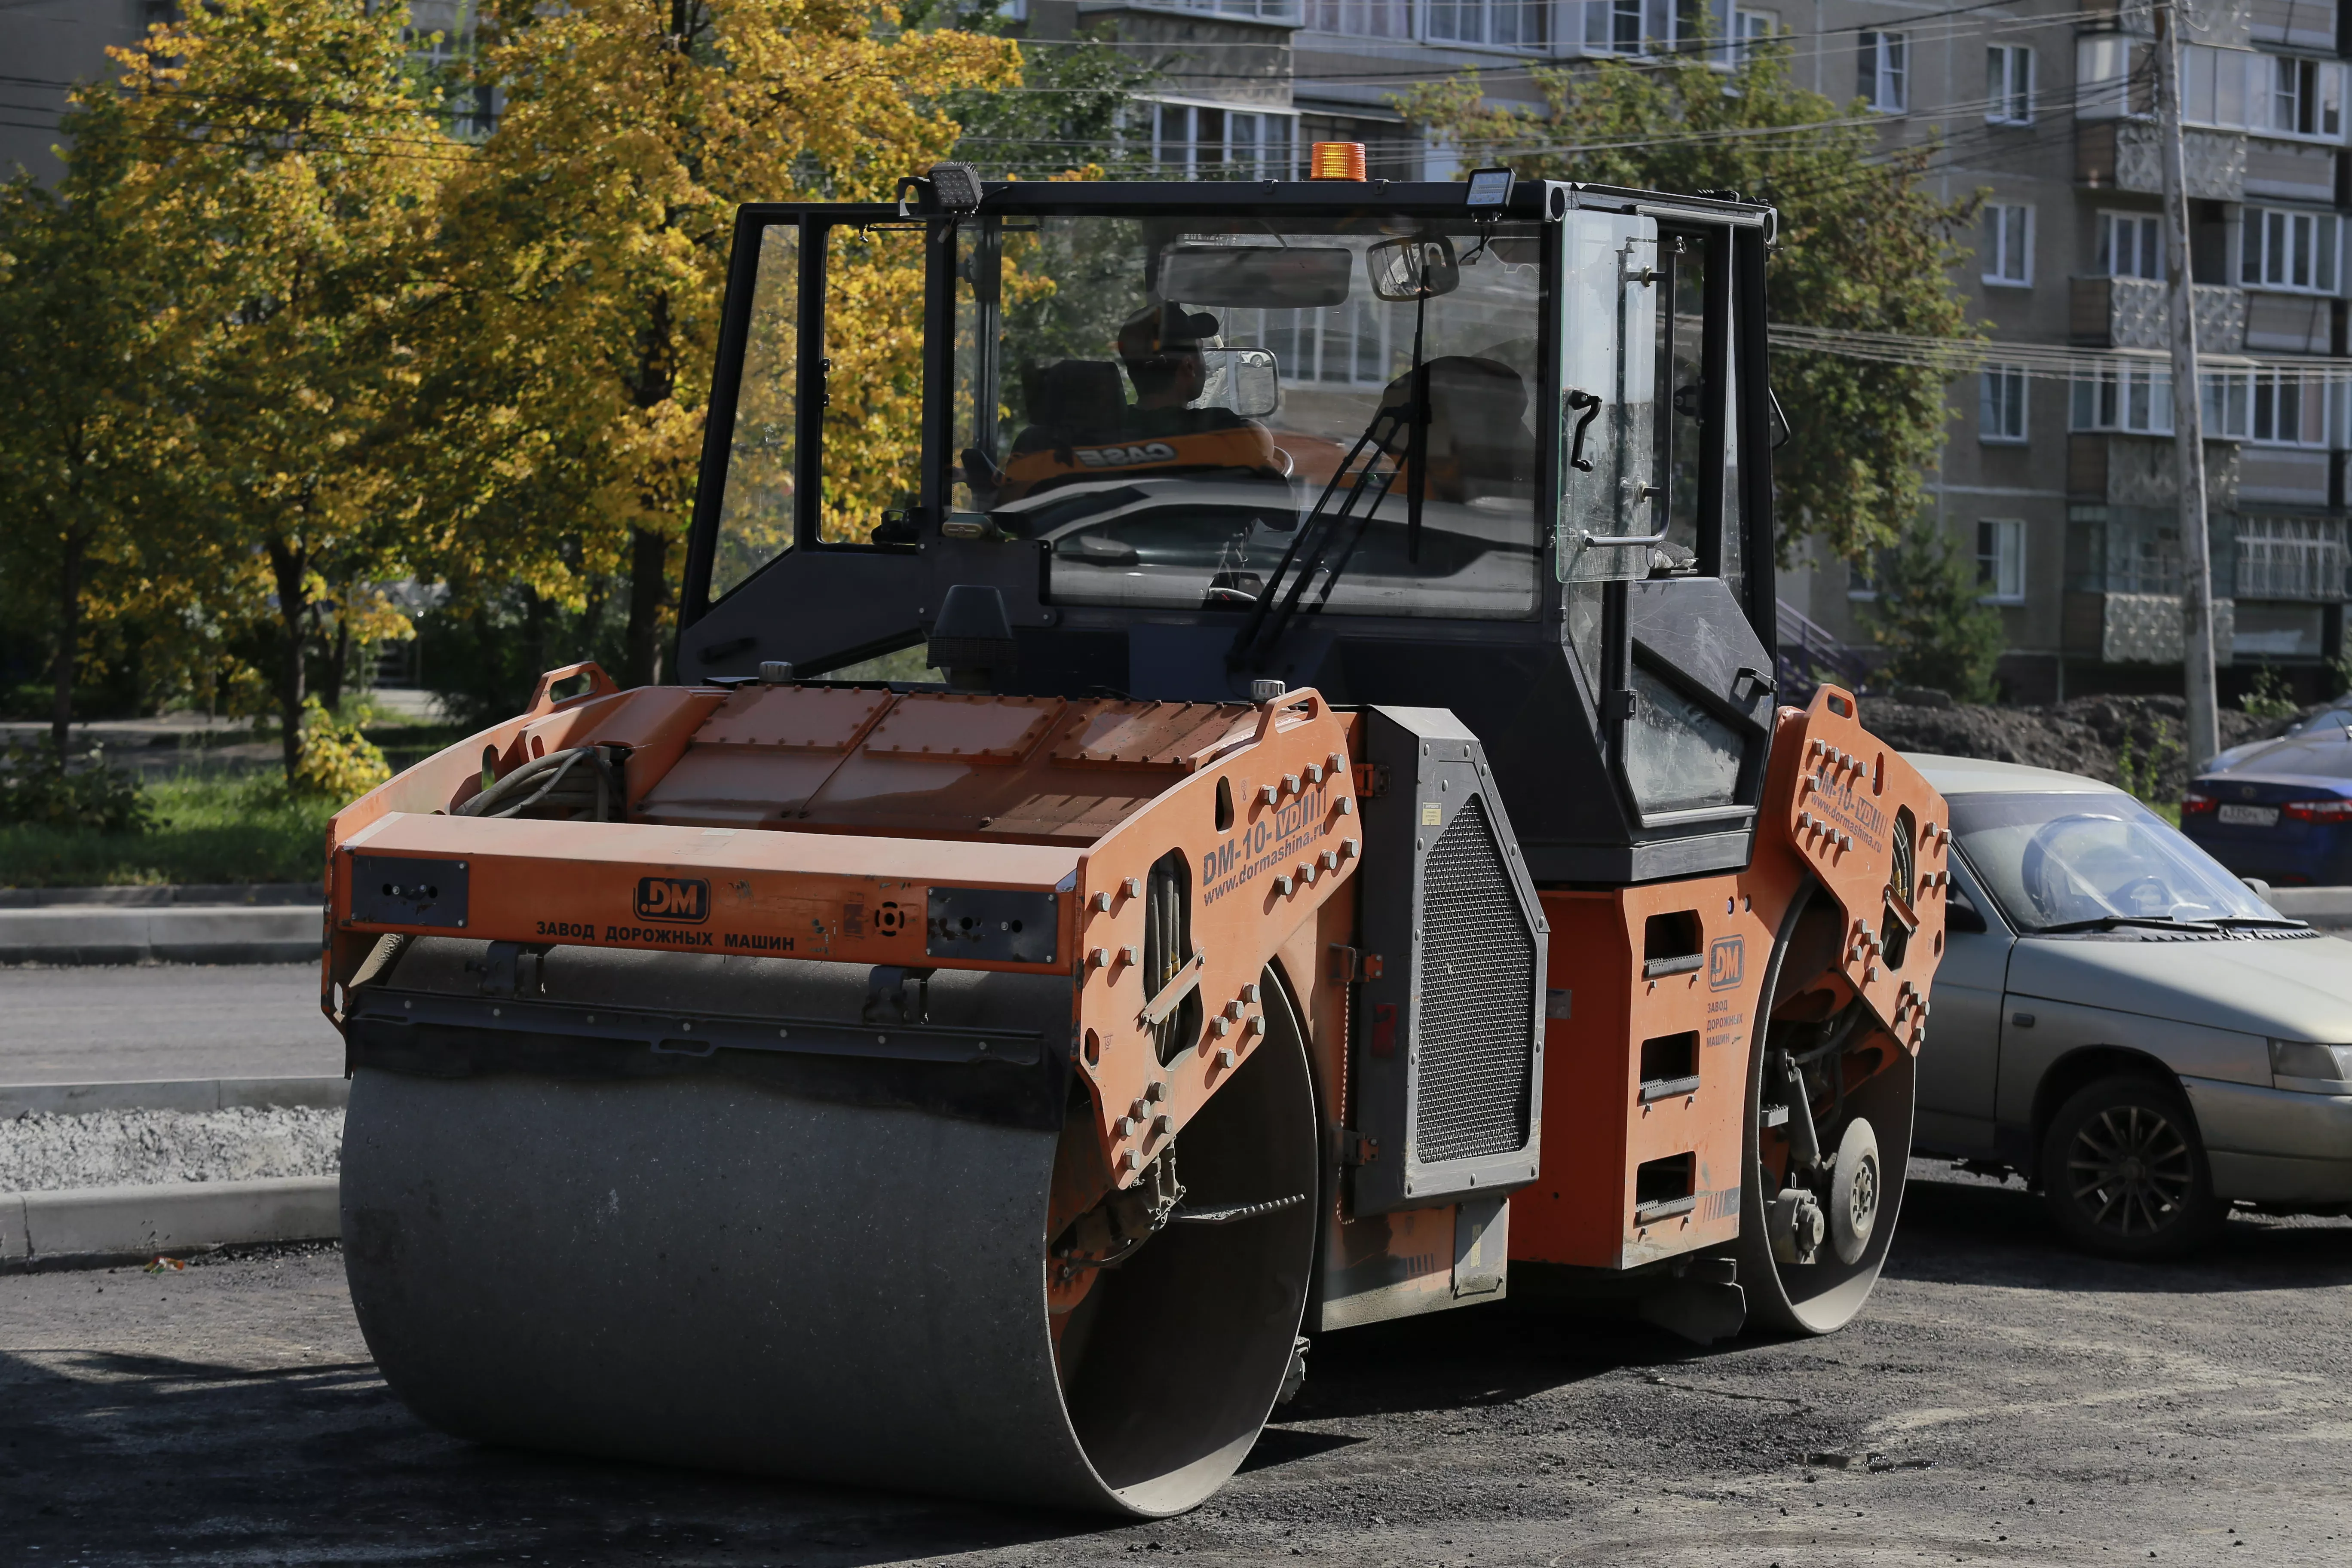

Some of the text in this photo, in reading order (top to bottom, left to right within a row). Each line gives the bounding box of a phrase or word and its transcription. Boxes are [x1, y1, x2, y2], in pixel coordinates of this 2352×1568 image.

[1811, 793, 1883, 854] www.dormashina.ru
[1204, 821, 1326, 906] www.dormashina.ru
[536, 921, 795, 951] ЗАВОД ДОРОЖНЫХ МАШИН
[1707, 999, 1728, 1014] ЗАВОД
[1706, 1013, 1743, 1033] ДОРОЖНЫХ
[1706, 1033, 1730, 1048] МАШИН
